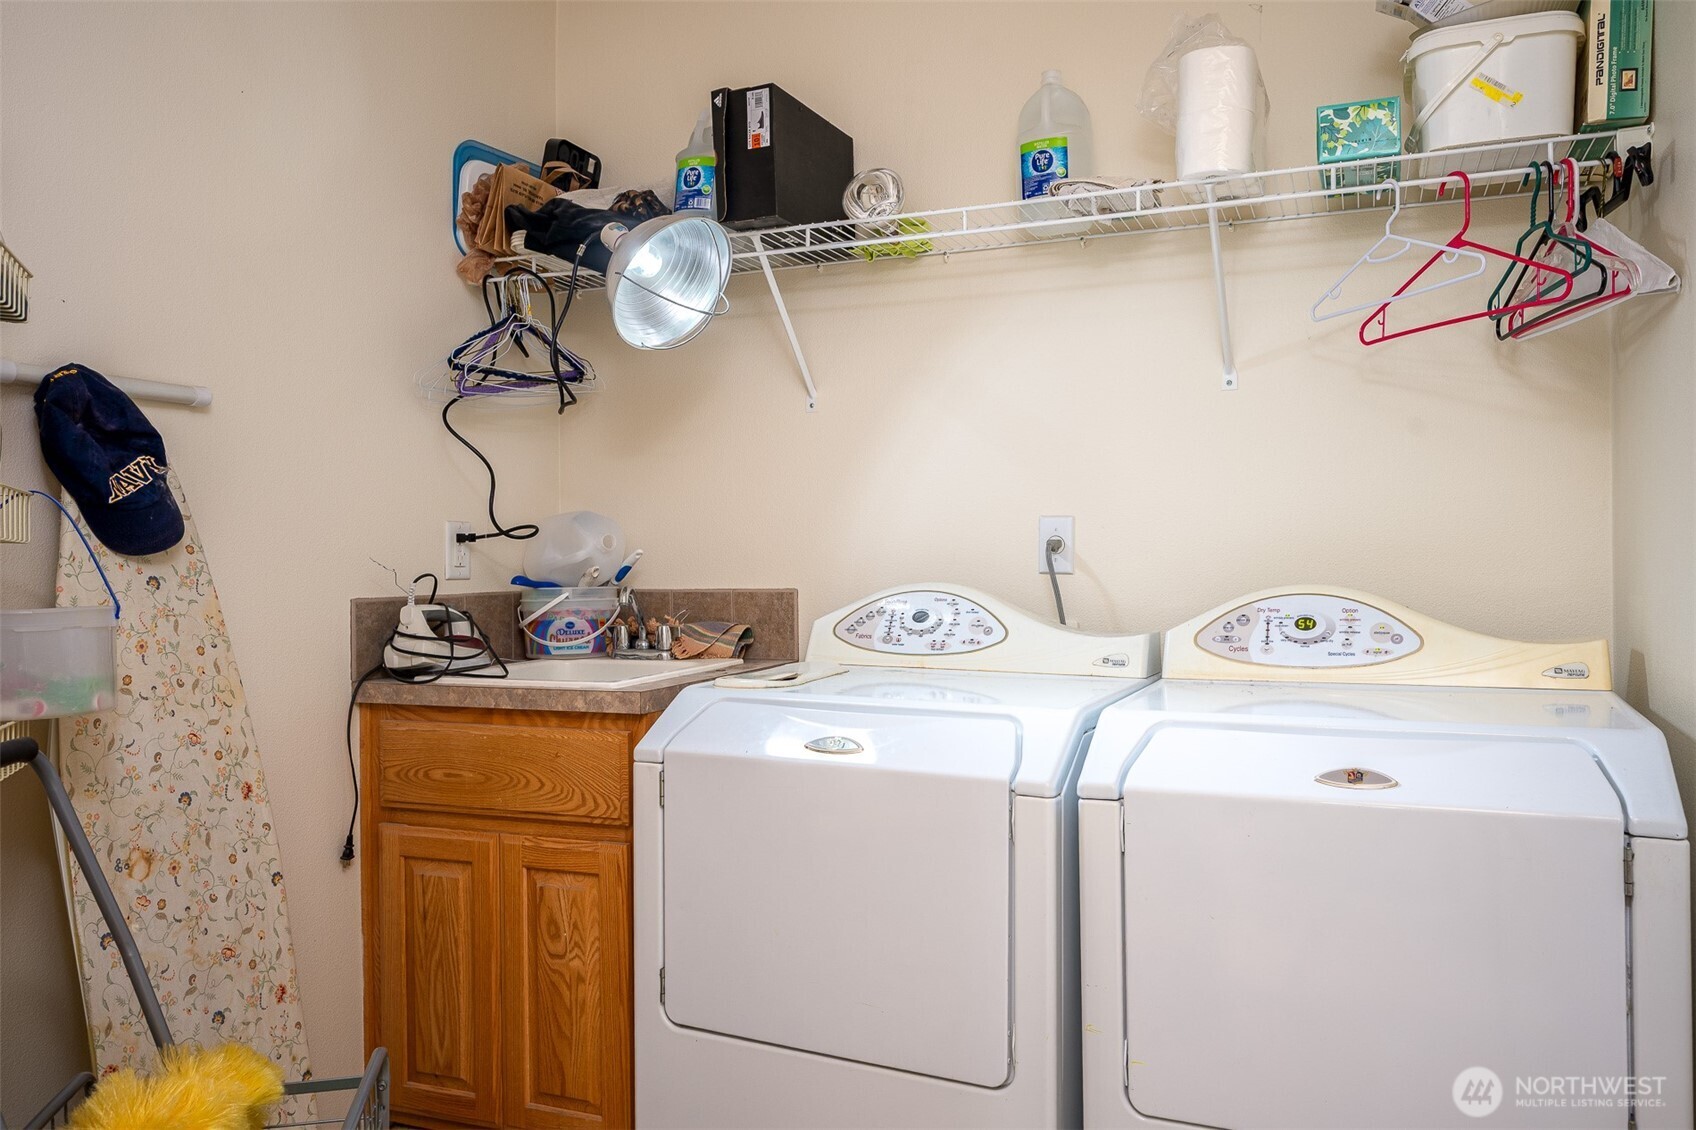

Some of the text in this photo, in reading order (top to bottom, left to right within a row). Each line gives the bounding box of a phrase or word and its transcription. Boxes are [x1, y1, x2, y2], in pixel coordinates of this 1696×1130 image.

[1610, 83, 1618, 102] Digital
[1034, 152, 1050, 161] Pure
[1036, 158, 1049, 167] Life
[1298, 619, 1314, 629] 54
[855, 632, 872, 640] Fabrics
[1228, 645, 1249, 653] Cycles
